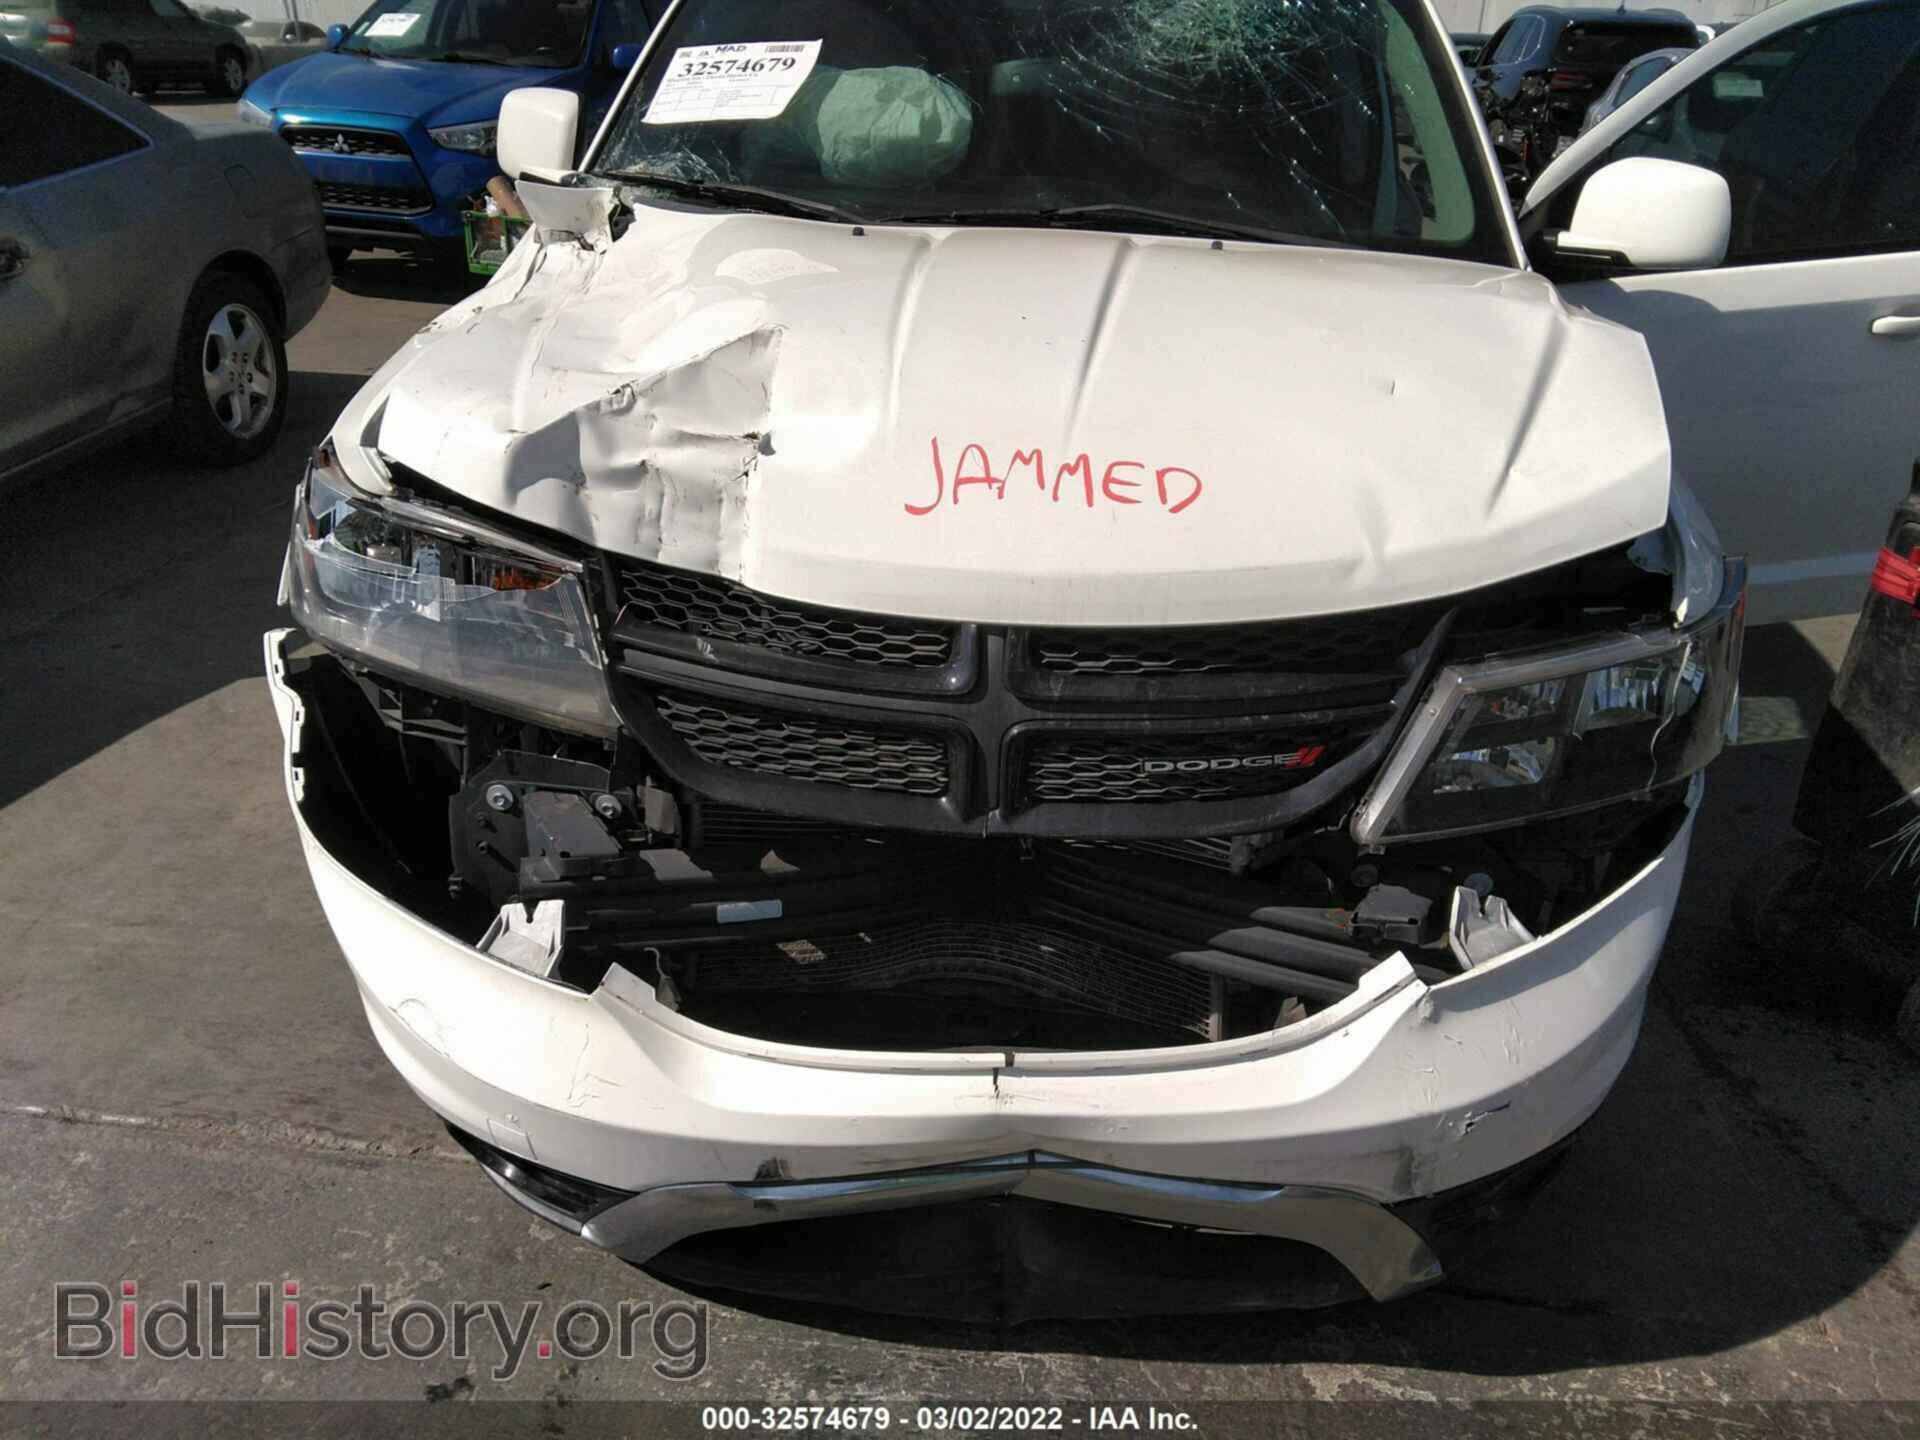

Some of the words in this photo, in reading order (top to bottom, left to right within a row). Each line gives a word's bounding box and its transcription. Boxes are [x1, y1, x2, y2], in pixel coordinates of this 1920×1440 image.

[678, 57, 796, 77] 32574679
[904, 436, 1203, 515] JAMMED
[1144, 752, 1301, 772] DODGE
